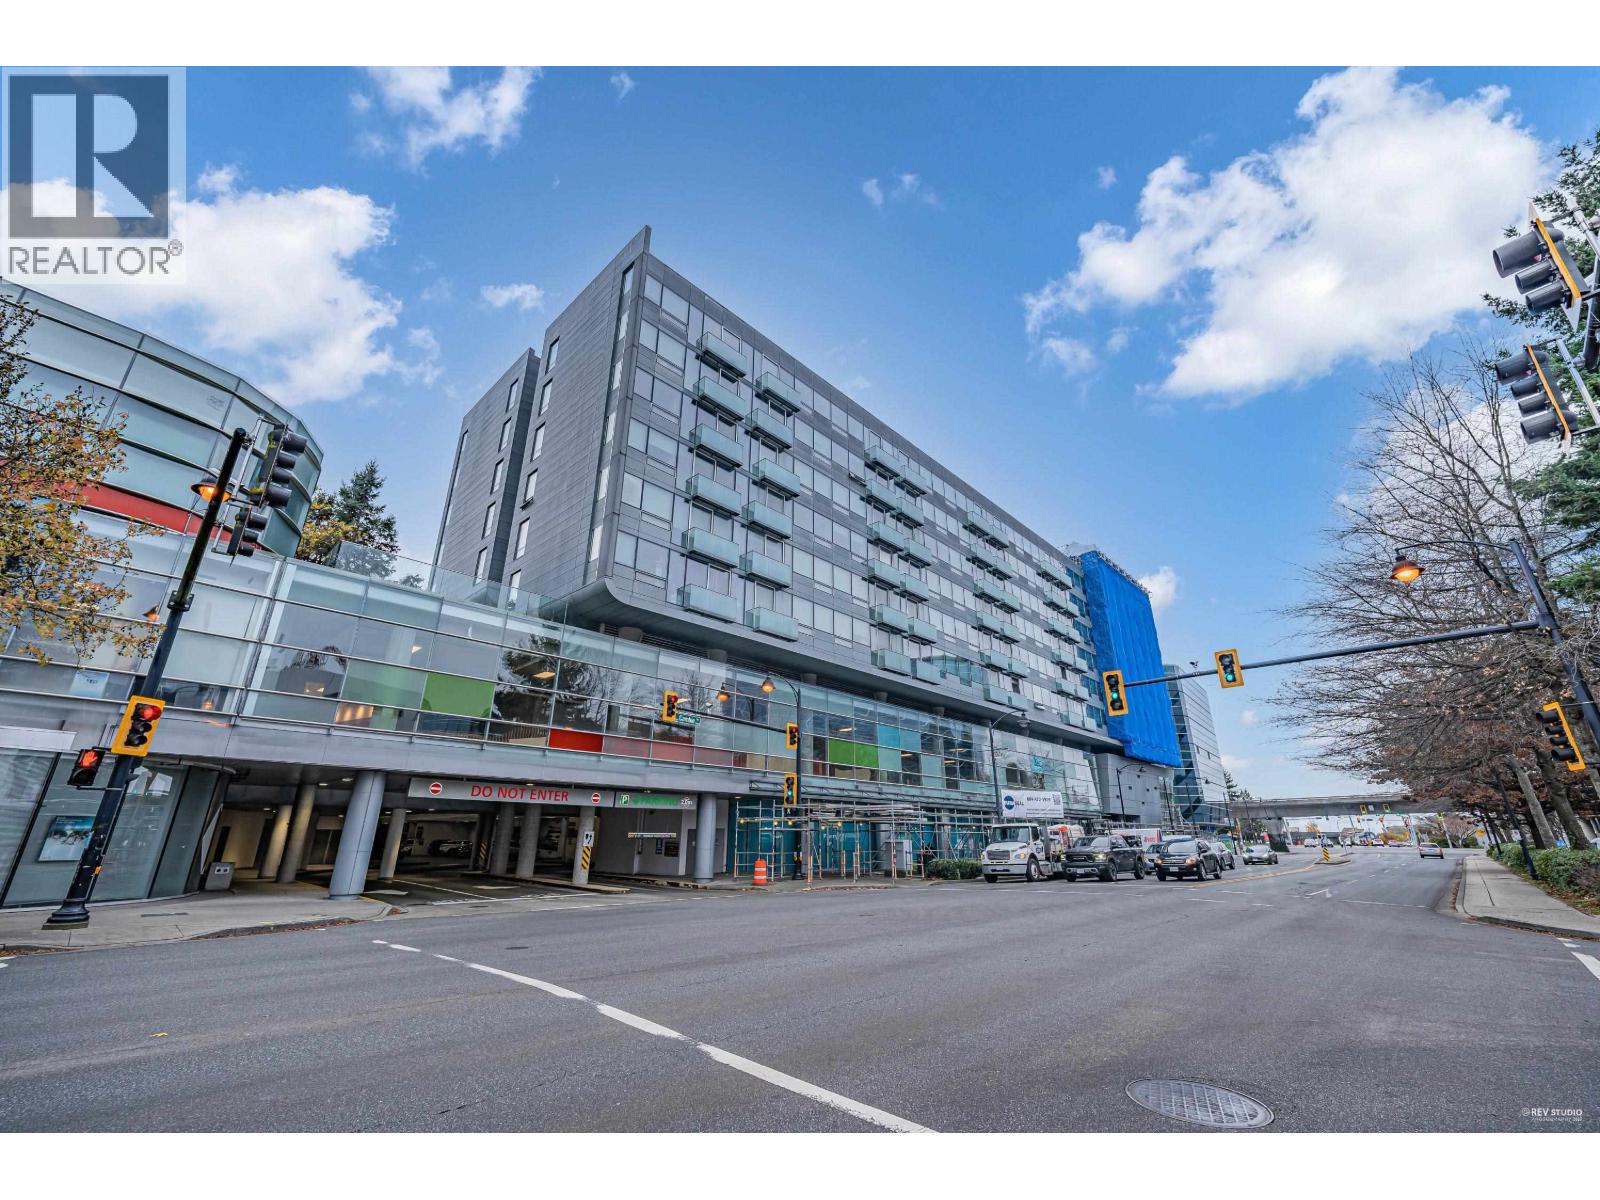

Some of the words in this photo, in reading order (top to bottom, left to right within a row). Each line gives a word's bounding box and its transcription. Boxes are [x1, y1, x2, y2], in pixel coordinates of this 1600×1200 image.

[471, 785, 493, 798] DO
[498, 785, 527, 799] NOT
[530, 788, 569, 801] ENTER
